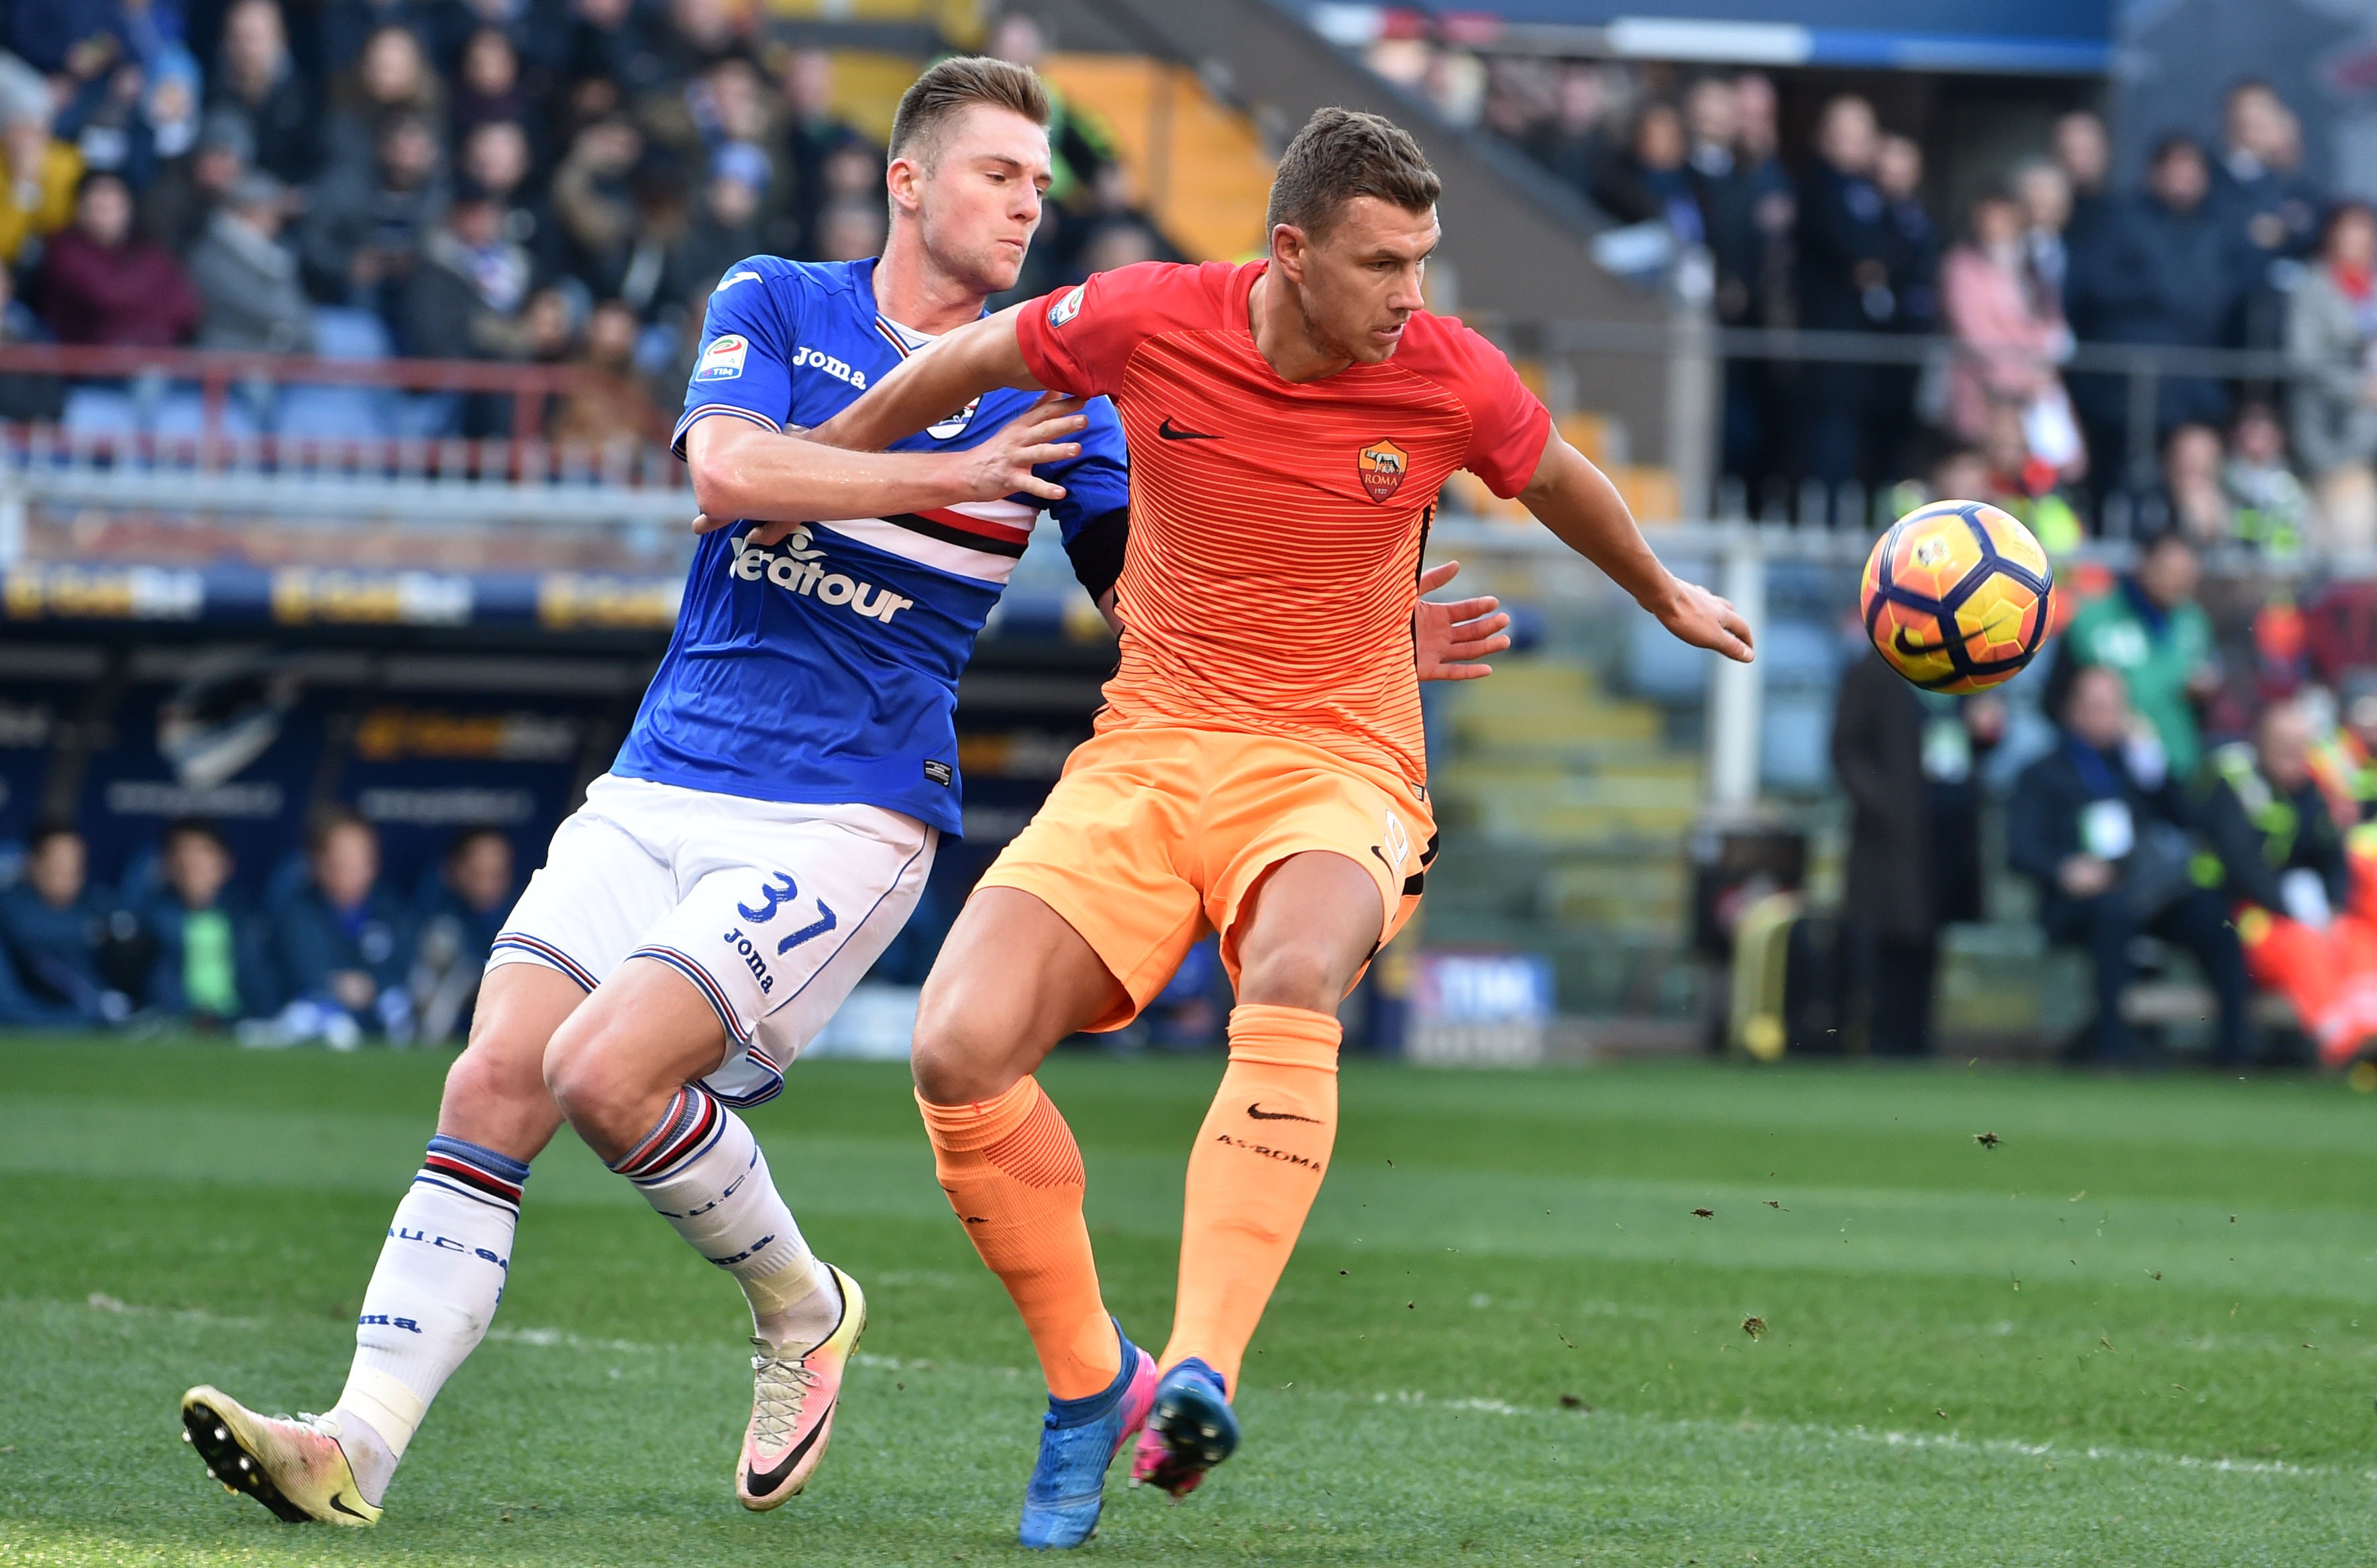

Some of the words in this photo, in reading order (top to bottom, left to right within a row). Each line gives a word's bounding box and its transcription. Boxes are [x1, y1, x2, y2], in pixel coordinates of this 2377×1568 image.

[713, 368, 733, 376] TIM
[792, 346, 867, 390] Joma
[1365, 474, 1398, 487] ROMA
[737, 870, 837, 956] 37
[723, 927, 774, 994] Joma
